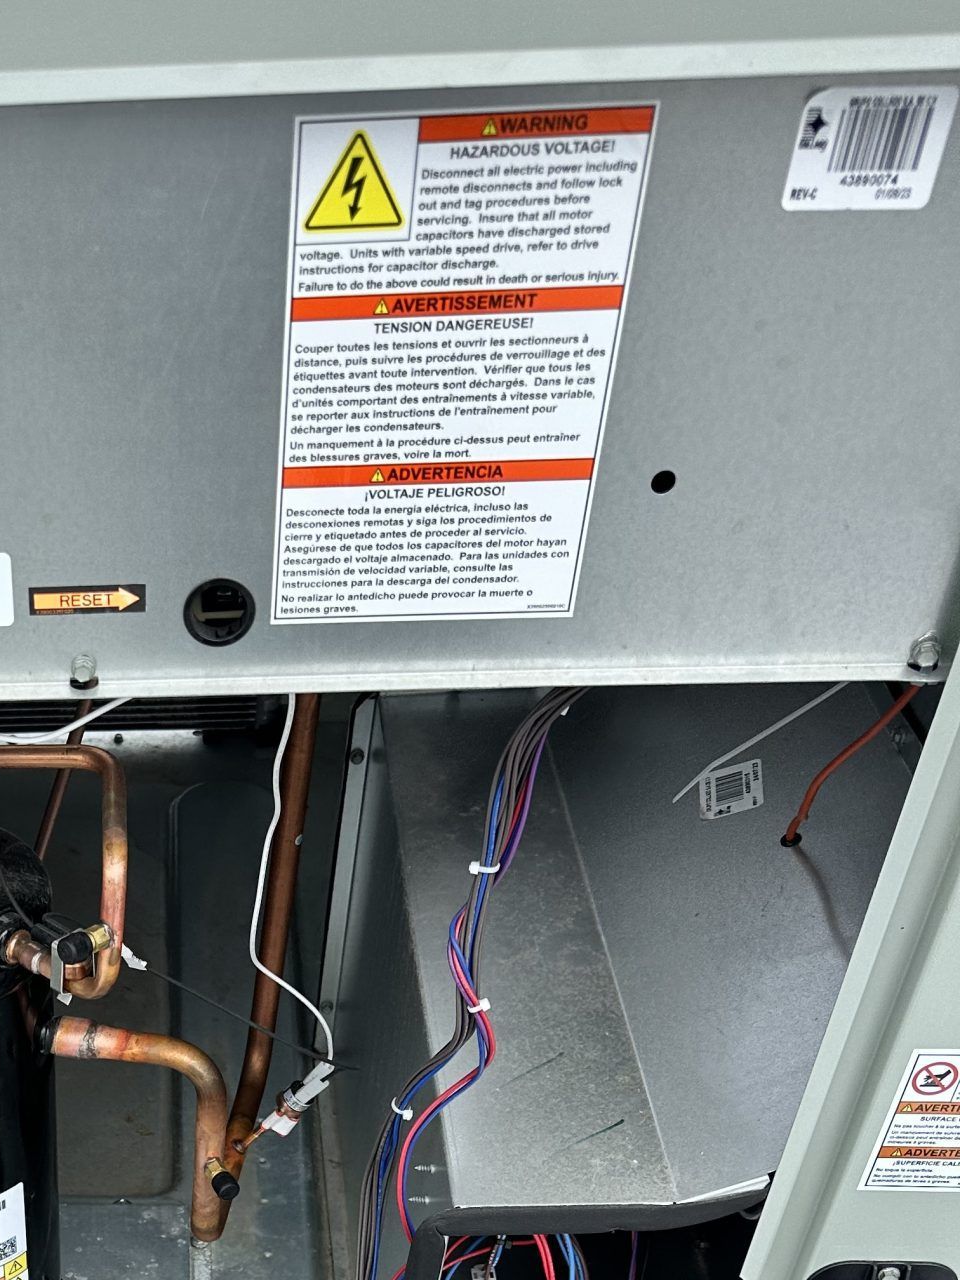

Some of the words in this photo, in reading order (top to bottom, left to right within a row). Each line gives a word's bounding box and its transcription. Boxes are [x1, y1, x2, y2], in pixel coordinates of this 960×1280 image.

[499, 113, 588, 133] WARNING
[449, 143, 540, 159] HAZARDOUS
[544, 140, 616, 155] VOLTAGE!
[421, 167, 485, 180] Disconnect
[486, 165, 501, 177] all
[503, 164, 544, 176] electric
[547, 164, 583, 176] power
[585, 160, 638, 173] including
[419, 183, 460, 195] remote
[462, 180, 532, 193] disconnects
[535, 179, 558, 190] and
[560, 177, 596, 189] follow
[598, 175, 623, 187] lock
[418, 200, 437, 211] out
[439, 198, 462, 210] and
[464, 198, 482, 211] tag
[485, 195, 550, 210] procedures
[553, 193, 590, 205] before
[416, 214, 471, 227] servicing.
[478, 212, 514, 223] Insure
[517, 211, 539, 222] that
[542, 209, 556, 221] all
[558, 209, 593, 220] motor
[415, 229, 474, 243] capacitors
[477, 228, 504, 238] have
[507, 224, 571, 238] discharged
[573, 223, 610, 235] stored
[299, 250, 343, 262] voltage.
[349, 248, 378, 259] Units
[381, 246, 405, 257] with
[408, 244, 452, 256] variable
[455, 243, 490, 256] speed
[492, 242, 523, 253] drive,
[526, 240, 553, 251] refer
[556, 240, 567, 250] to
[570, 239, 599, 250] drive
[299, 264, 364, 275] instructions
[367, 262, 384, 273] for
[386, 260, 438, 274] capacitor
[440, 258, 498, 271] discharge.
[391, 293, 538, 313] AVERTISSEMENT
[374, 321, 432, 334] TENSION
[435, 317, 534, 332] DANGEREUSE!
[294, 344, 334, 355] Couper
[336, 343, 370, 352] toutes
[373, 341, 389, 351] les
[392, 340, 438, 350] tensions
[441, 339, 452, 348] et
[454, 337, 487, 348] ouvrir
[489, 337, 505, 347] les
[508, 335, 579, 346] sectionneurs
[582, 333, 589, 343] à
[387, 465, 503, 481] ADVERTENCIA
[364, 488, 424, 502] ¡VOLTAJE
[427, 485, 505, 498] PELIGROSO!
[286, 507, 345, 517] Desconecte
[347, 506, 370, 515] toda
[372, 505, 381, 514] la
[384, 504, 422, 515] energía
[424, 503, 470, 513] eléctrica,
[473, 502, 511, 511] incluso
[513, 501, 528, 510] las
[60, 594, 113, 607] RESET
